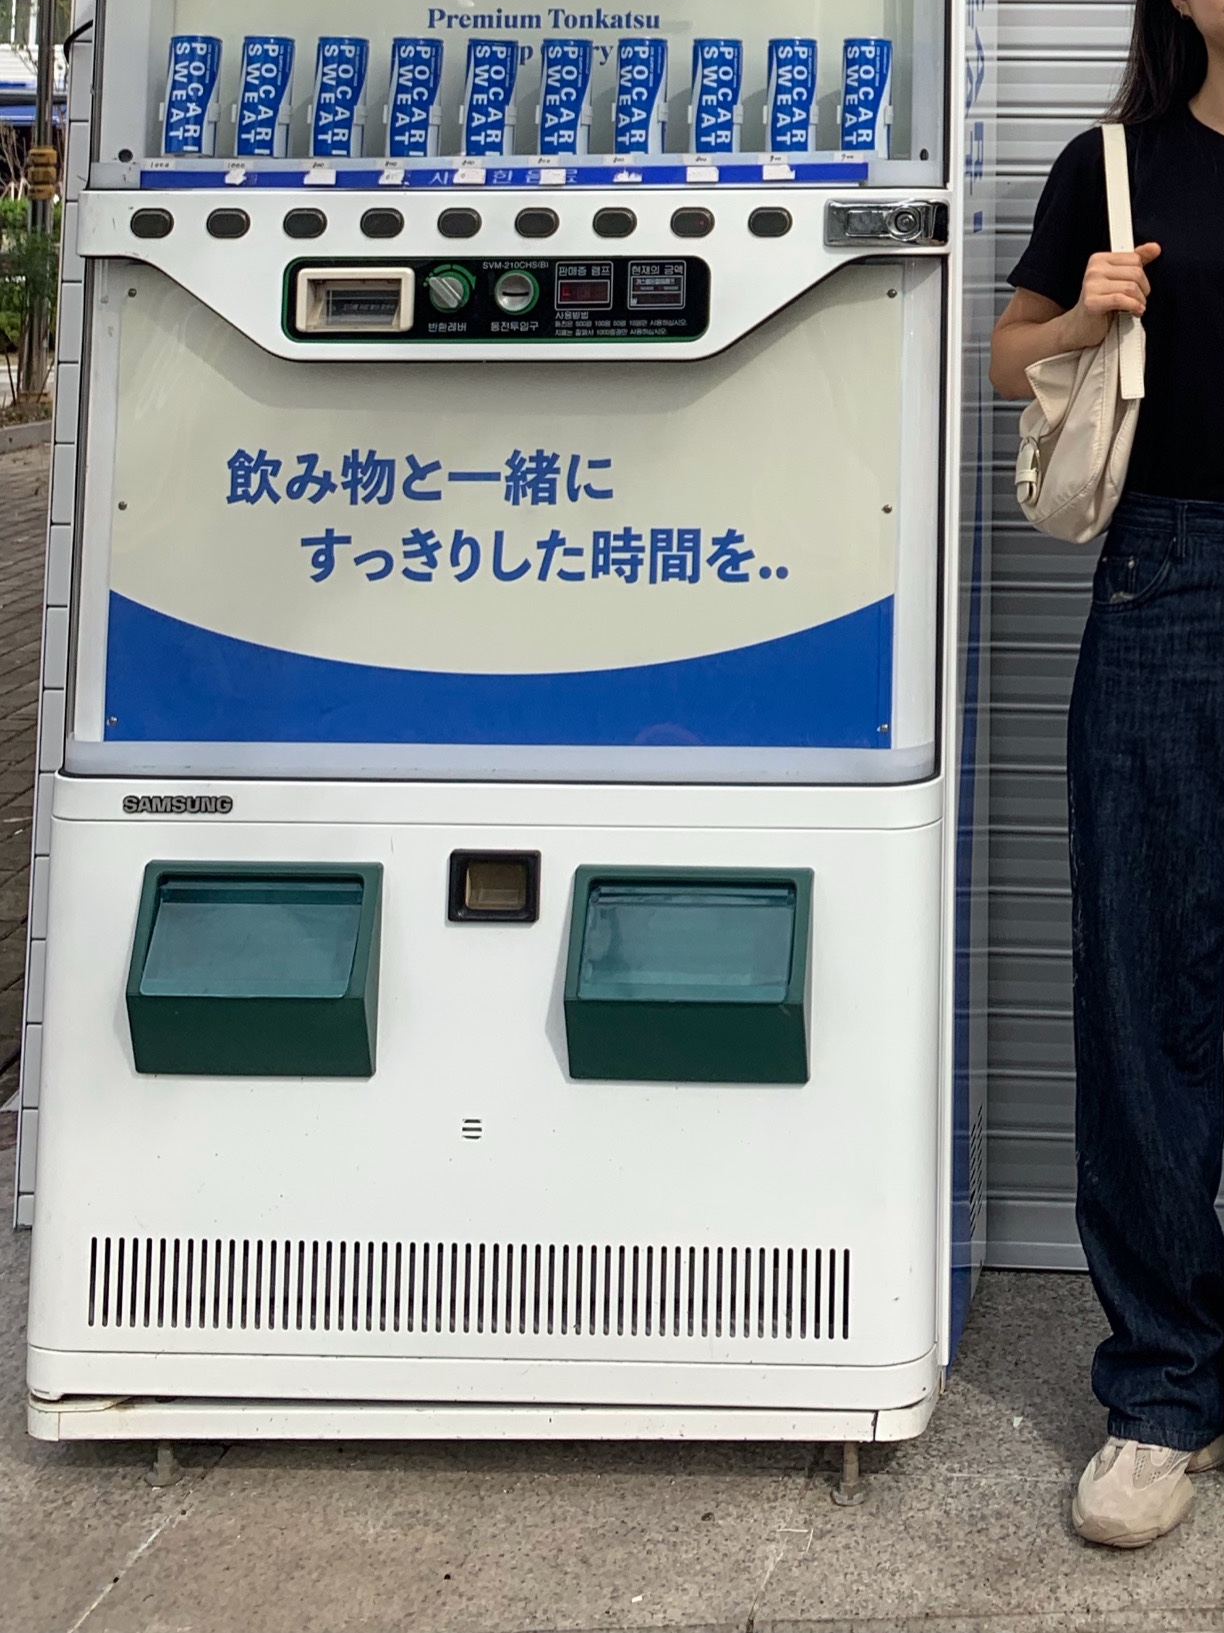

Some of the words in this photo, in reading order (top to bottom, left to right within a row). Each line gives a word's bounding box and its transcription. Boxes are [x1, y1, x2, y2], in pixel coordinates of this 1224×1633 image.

[427, 8, 542, 29] Premium
[548, 8, 661, 29] Tonkatsu
[168, 42, 190, 140] SWEAT
[183, 42, 207, 152] POCARI
[240, 43, 262, 143] SWEAT
[254, 44, 279, 155] POCARI
[317, 44, 339, 143] SWEAT
[331, 45, 356, 155] POCARI
[394, 45, 415, 145] SWEAT
[409, 47, 431, 156] POCARI
[470, 45, 490, 145] SWEAT
[544, 45, 563, 145] SWEAT
[617, 45, 633, 145] SWEAT
[700, 45, 719, 146] SWEAT
[716, 46, 734, 144] POCAR
[776, 46, 794, 145] SWEAT
[791, 46, 808, 144] POCAR
[844, 45, 860, 145] SWEAT
[857, 46, 876, 144] POCAR
[482, 260, 549, 270] SVM-210CHS(B)
[490, 321, 539, 332] 동전투입구
[225, 448, 615, 507] 飲み物と一緒に
[300, 526, 790, 585] すっきりした時間を..
[122, 795, 233, 814] SAMSUNG
